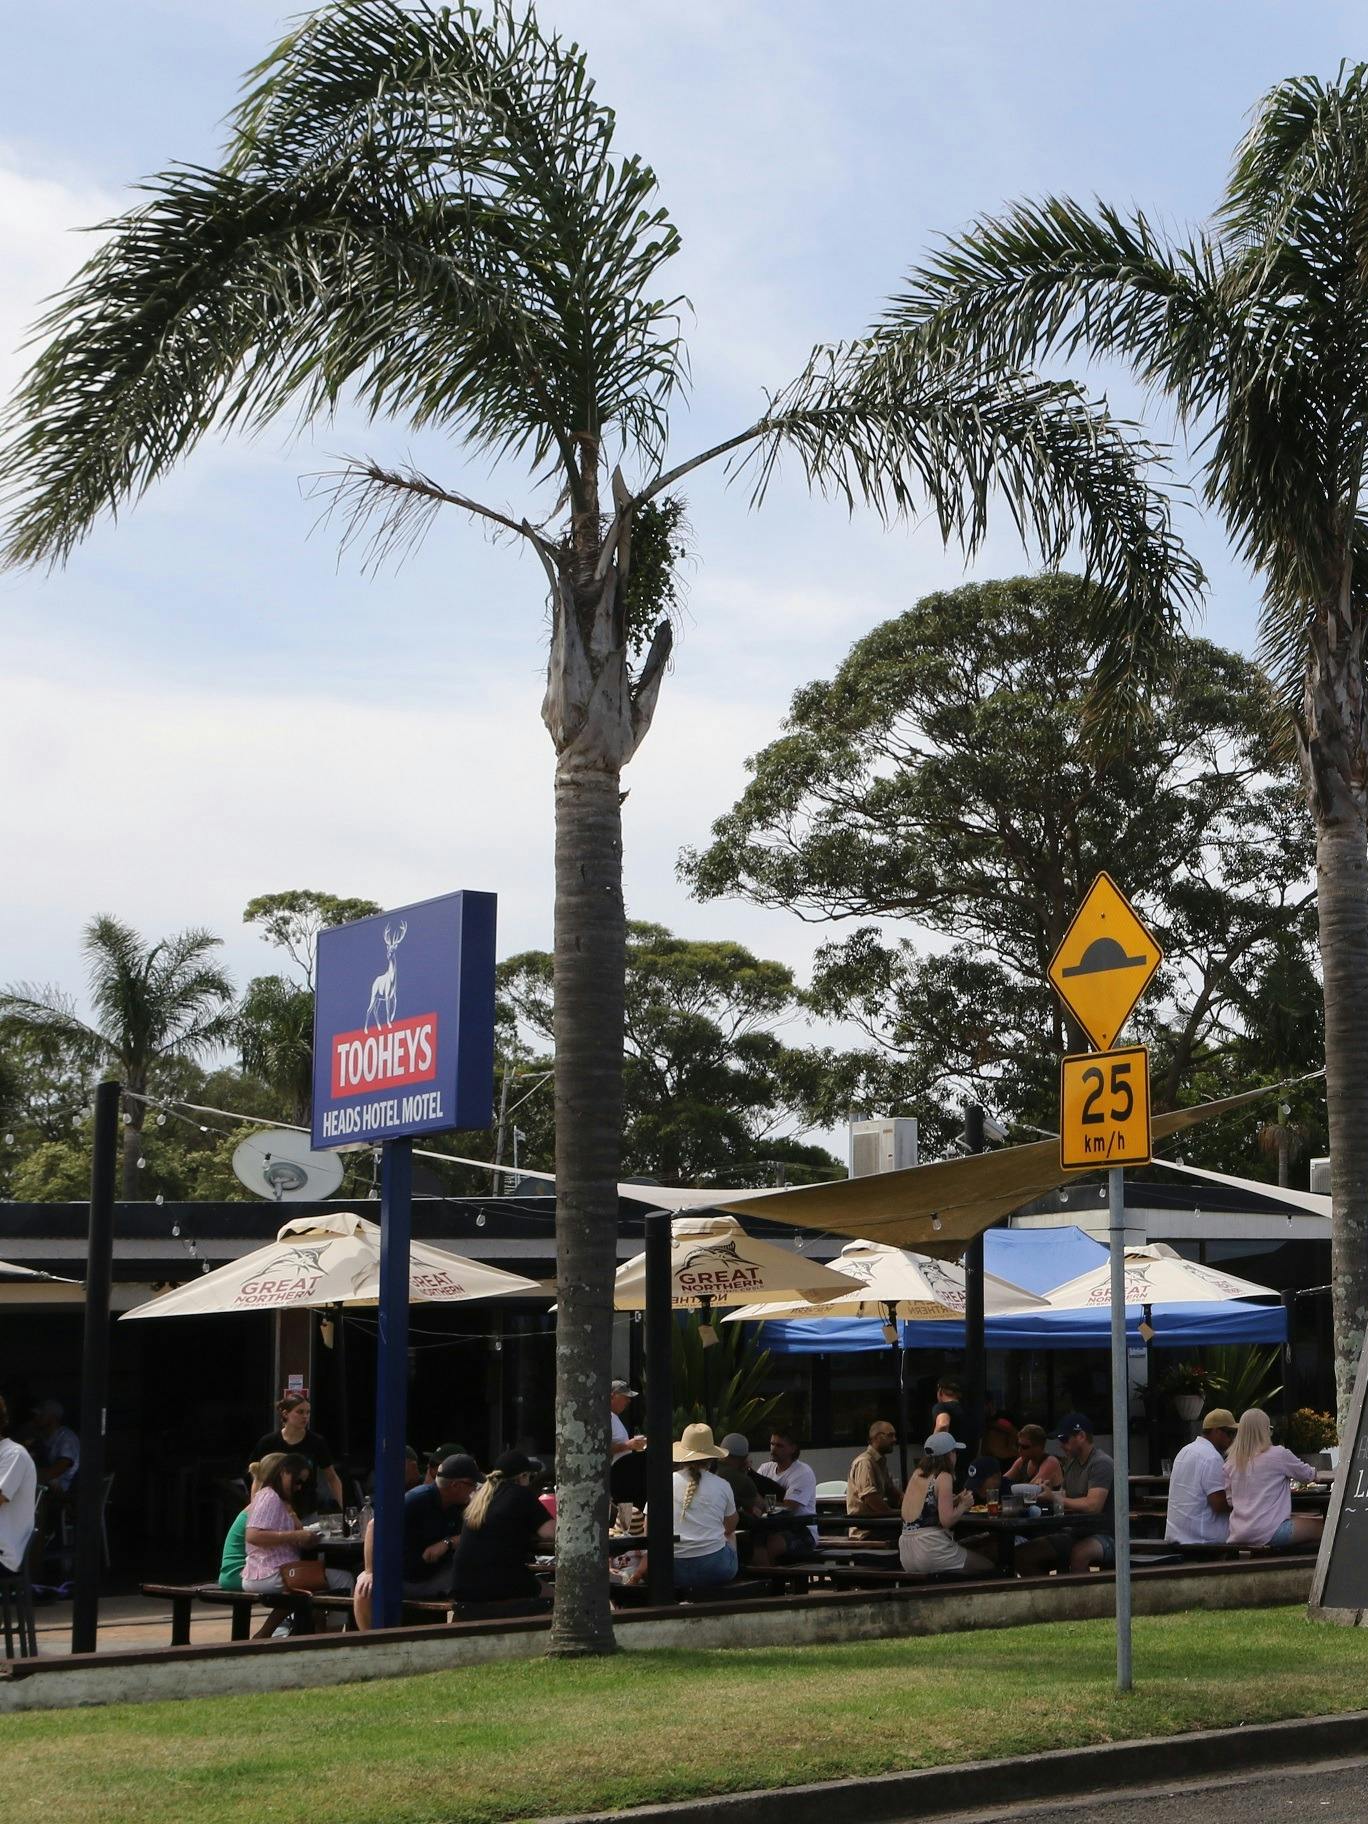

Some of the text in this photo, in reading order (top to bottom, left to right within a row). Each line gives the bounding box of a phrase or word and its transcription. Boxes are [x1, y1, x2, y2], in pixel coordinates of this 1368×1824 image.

[337, 1024, 433, 1088] TOOHEYS
[1081, 1063, 1134, 1125] 25
[323, 1091, 444, 1138] HEADS HOTEL MOTEL
[1084, 1131, 1125, 1158] km/h
[240, 1275, 324, 1295] GREAT
[679, 1267, 760, 1285] GREAT
[681, 1279, 764, 1292] NORTHERN
[234, 1289, 317, 1304] NORTHERN
[1087, 1293, 1148, 1303] NORERN
[1091, 1285, 1151, 1297] GRAT
